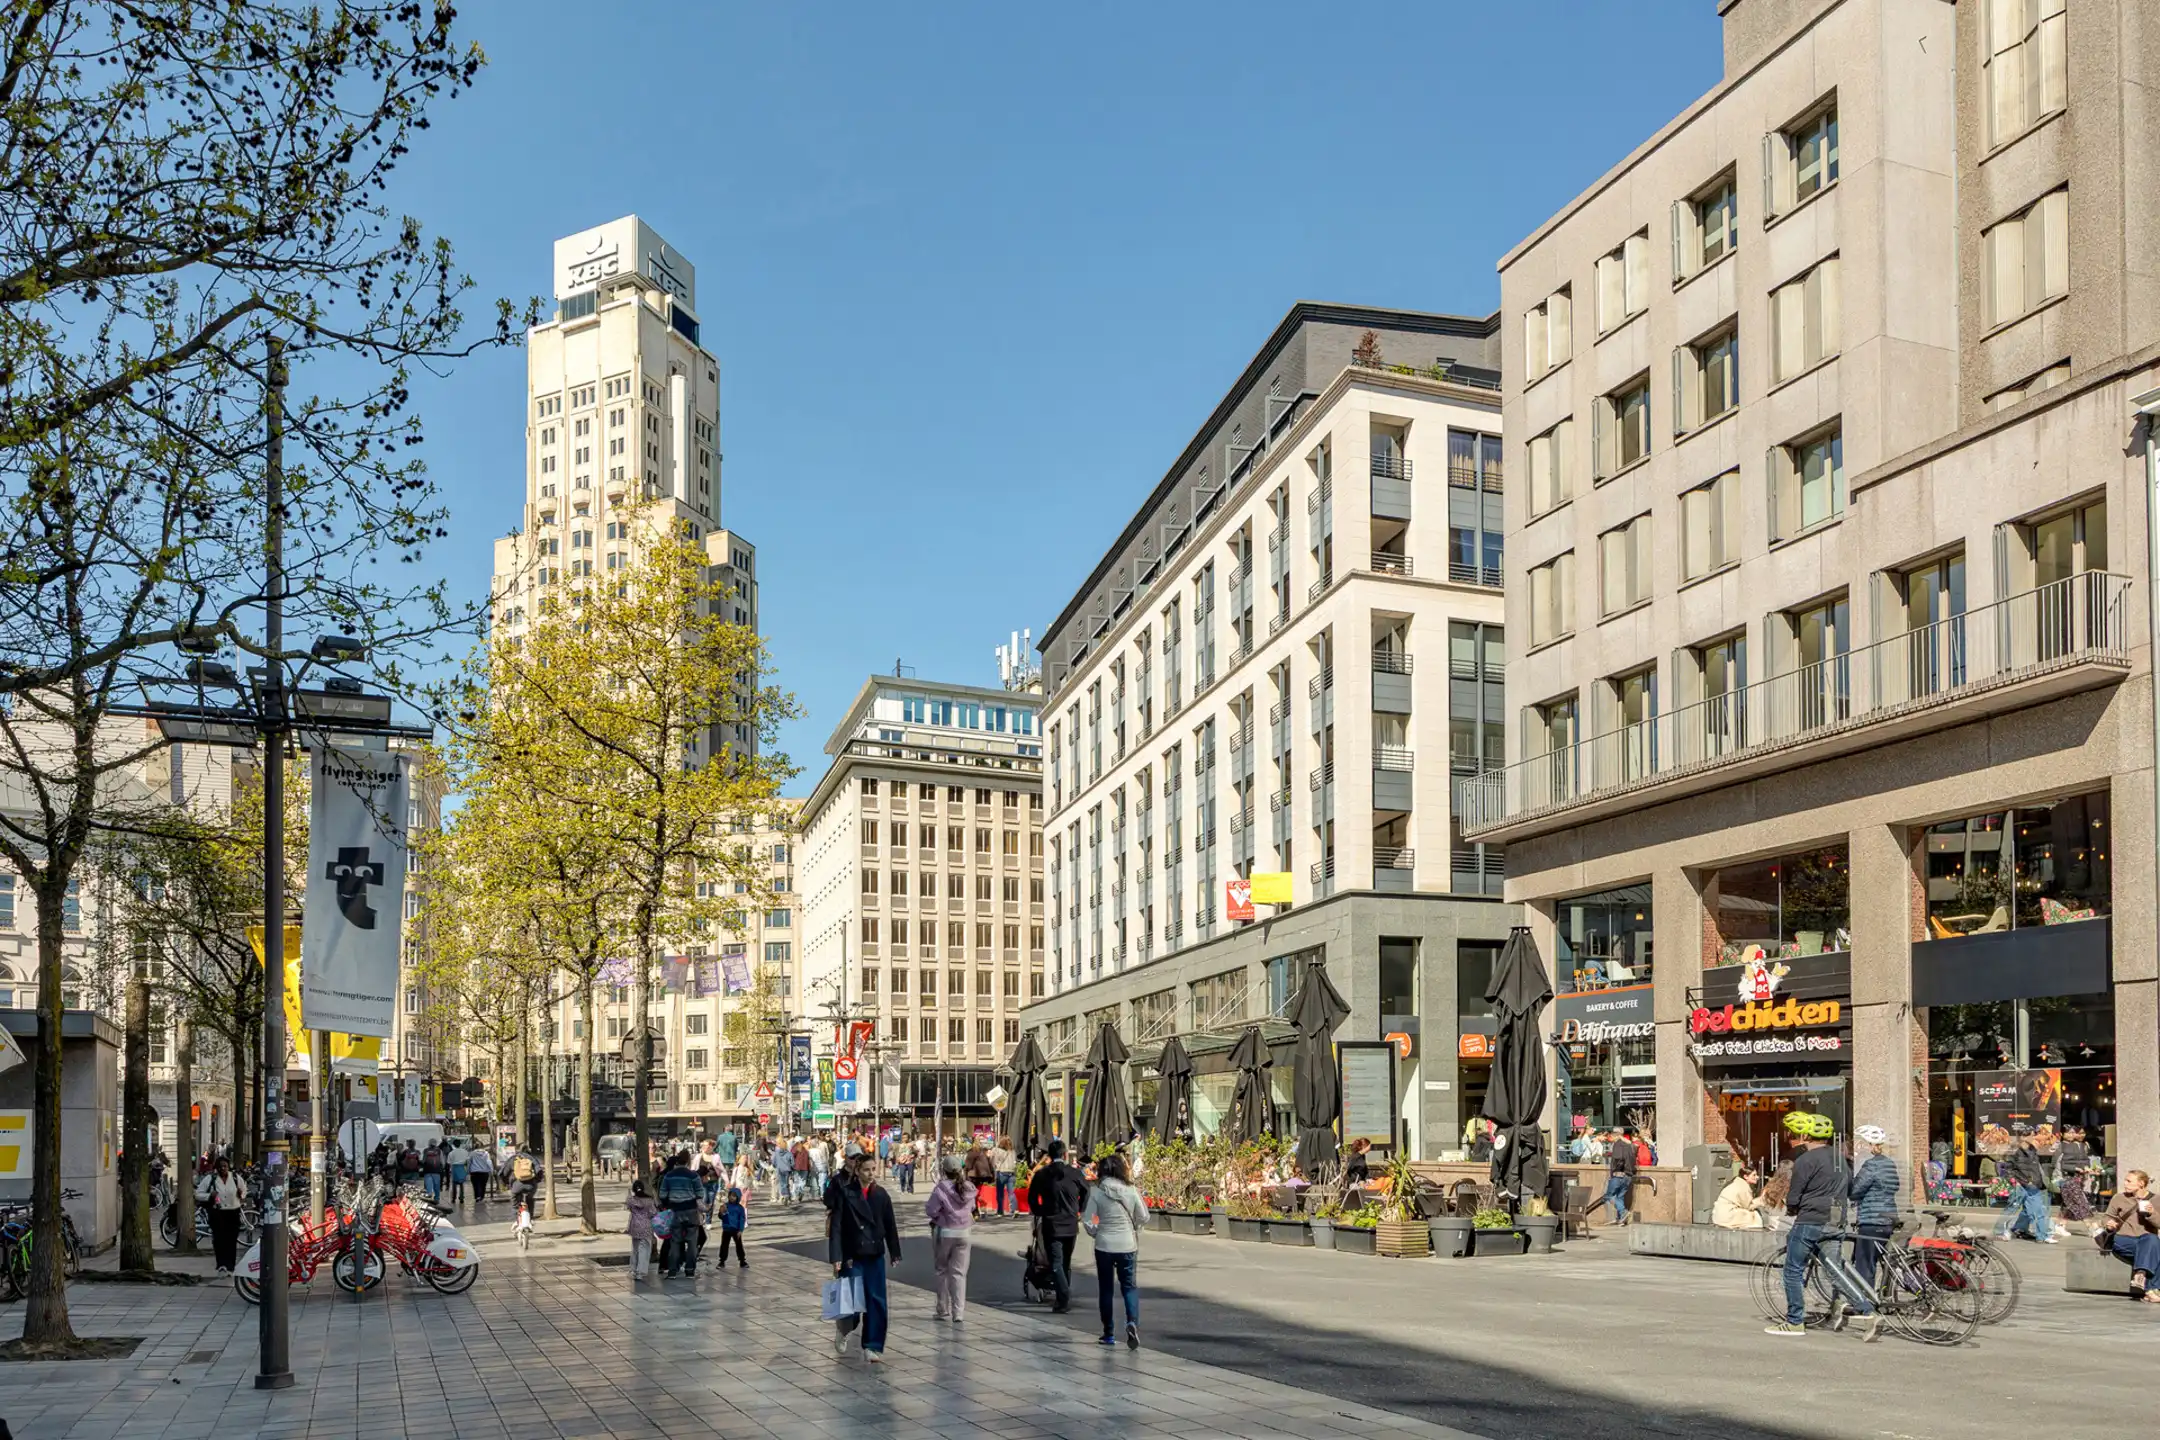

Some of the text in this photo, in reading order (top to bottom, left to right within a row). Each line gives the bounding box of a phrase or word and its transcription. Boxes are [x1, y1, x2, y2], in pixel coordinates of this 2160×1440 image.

[568, 257, 619, 288] KBC
[649, 262, 688, 300] KBC
[321, 764, 402, 783] flying tiger
[338, 780, 387, 790] copenhagen
[1756, 984, 1768, 993] BC
[1586, 1004, 1609, 1013] BAKERY
[1615, 999, 1638, 1010] COFFEE
[1692, 998, 1841, 1032] Belchicken
[1561, 1018, 1656, 1045] Délifrance
[1692, 1036, 1842, 1056] Finest Fried Chicken & More
